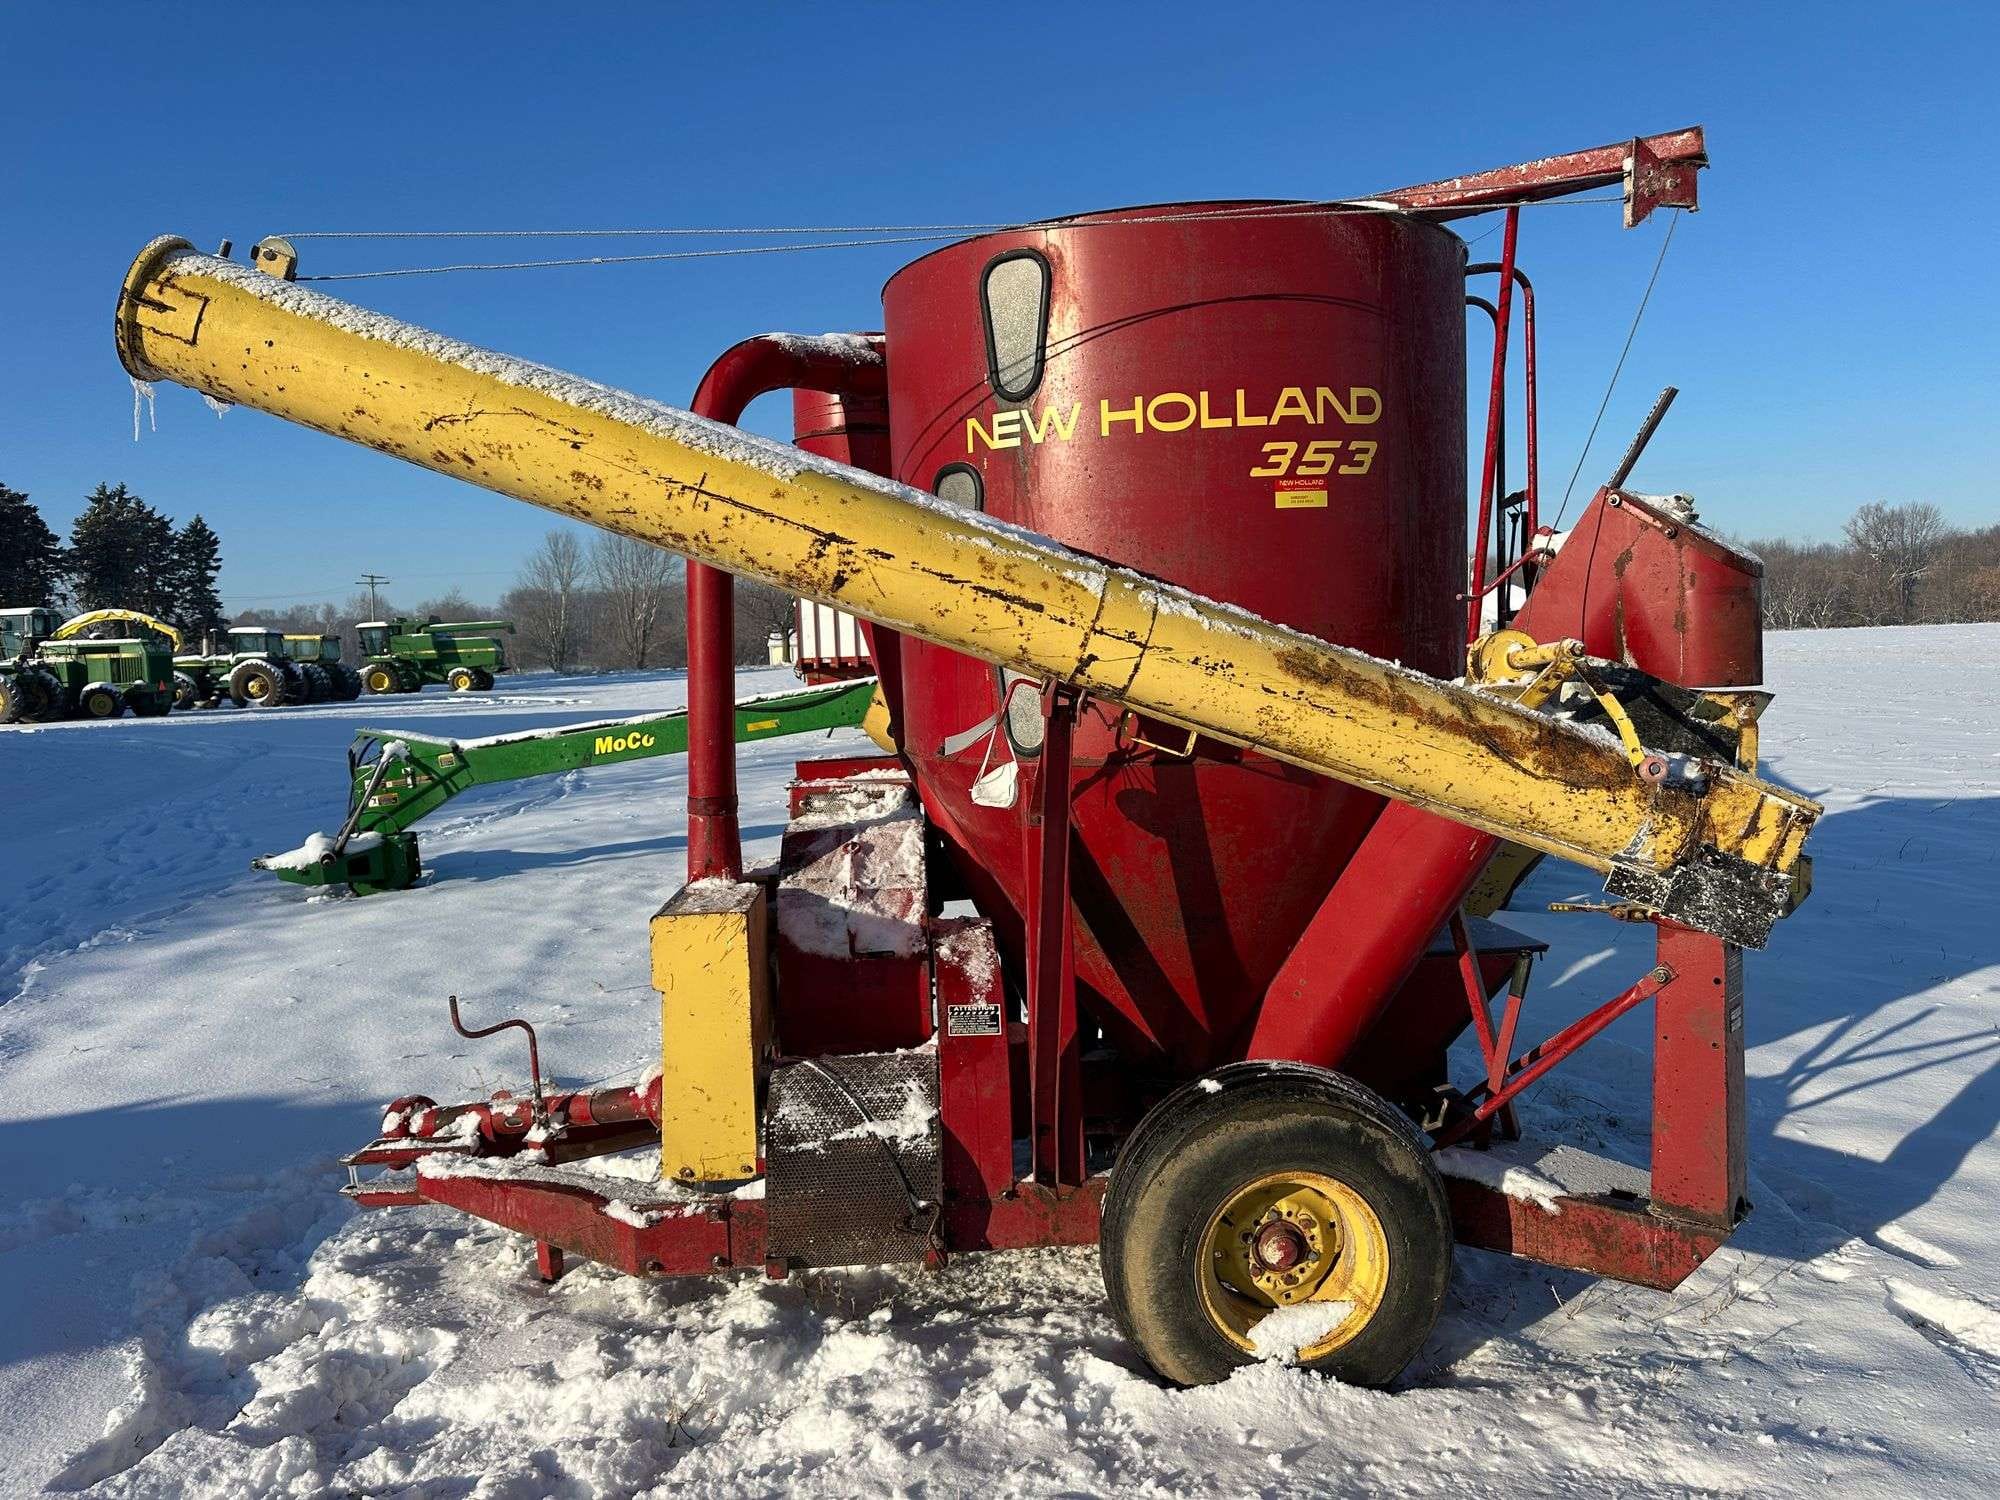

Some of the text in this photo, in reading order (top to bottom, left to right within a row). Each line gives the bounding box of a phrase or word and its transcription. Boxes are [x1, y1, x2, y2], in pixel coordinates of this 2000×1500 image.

[966, 387, 1382, 453] NEW HOLLAND
[1250, 441, 1378, 477] 353
